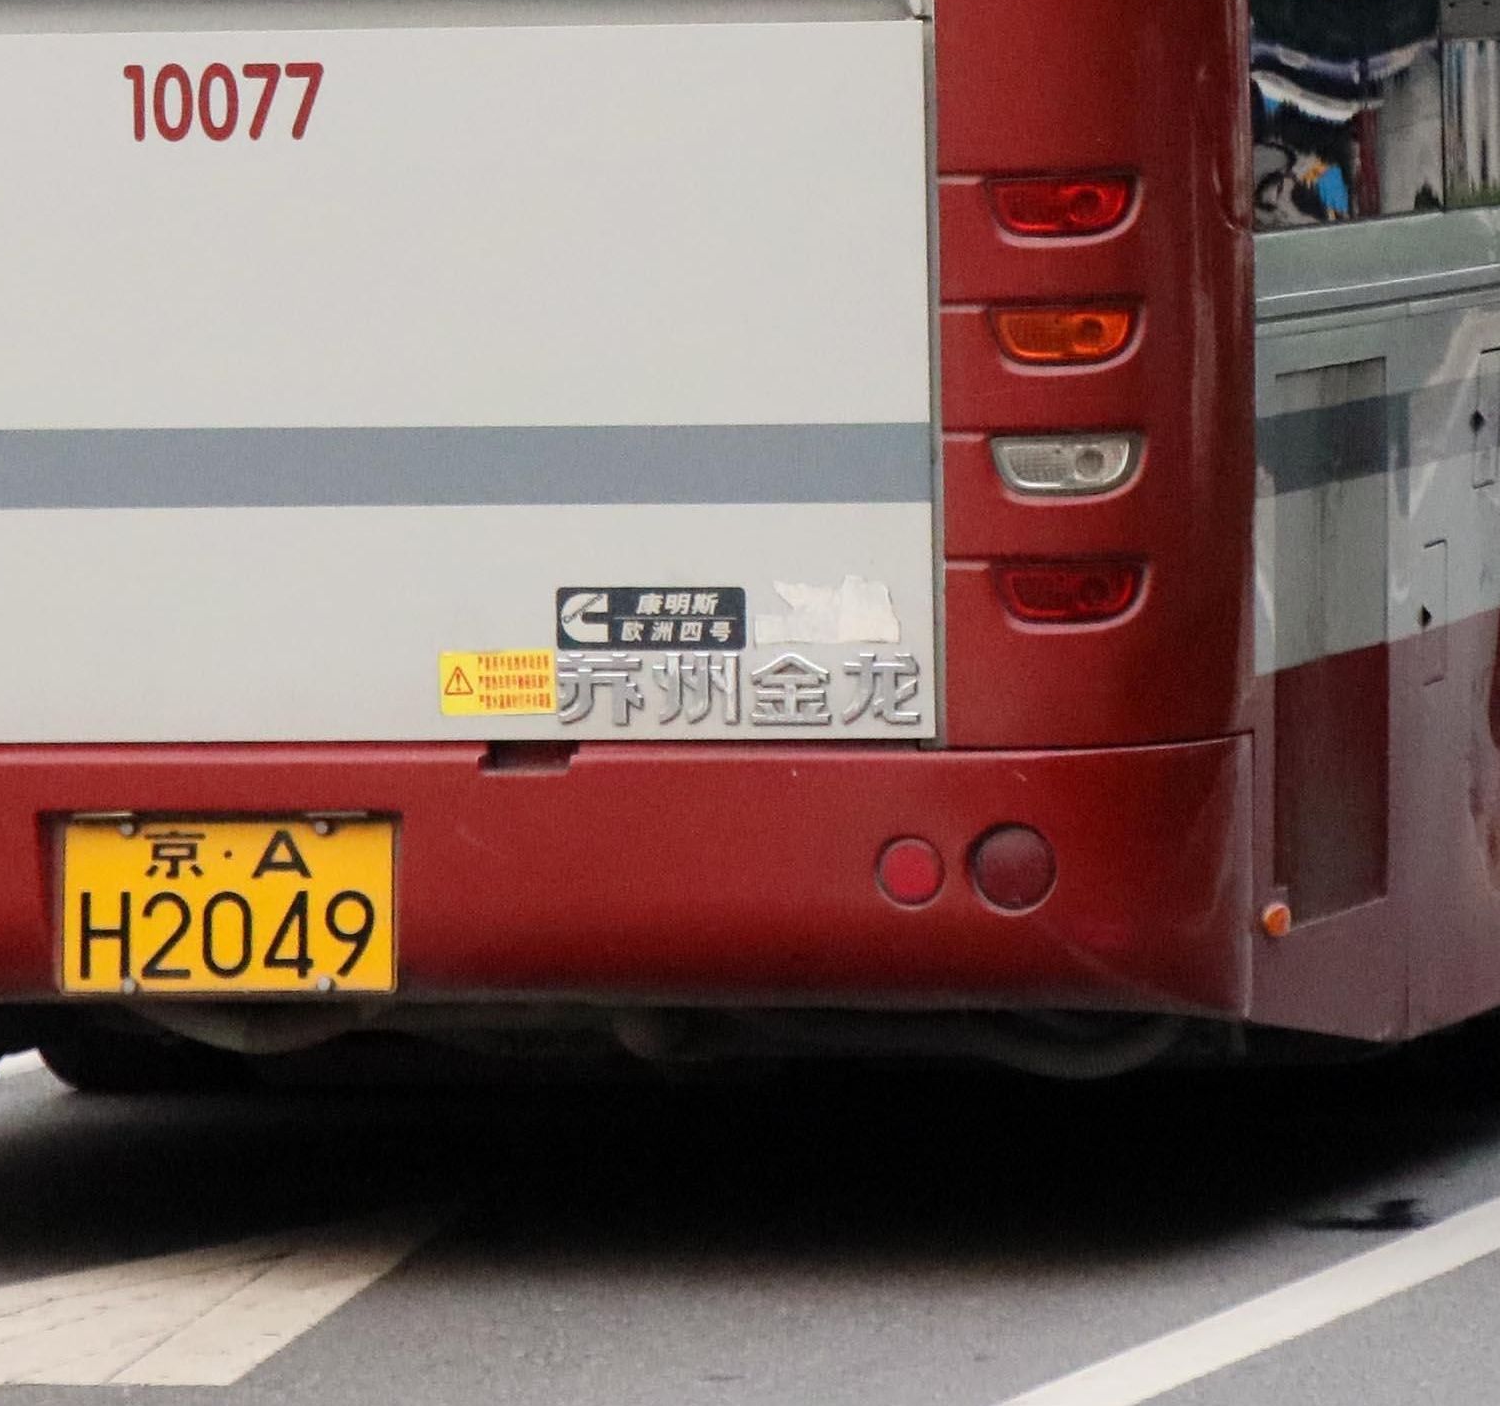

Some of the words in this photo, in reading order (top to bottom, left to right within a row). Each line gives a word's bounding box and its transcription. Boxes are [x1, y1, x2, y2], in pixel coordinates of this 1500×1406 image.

[123, 62, 325, 143] 10077
[620, 620, 733, 643] 欧洲四号
[635, 592, 720, 616] 康明斯
[556, 653, 922, 726] 苏州金龙
[79, 890, 376, 981] H2049
